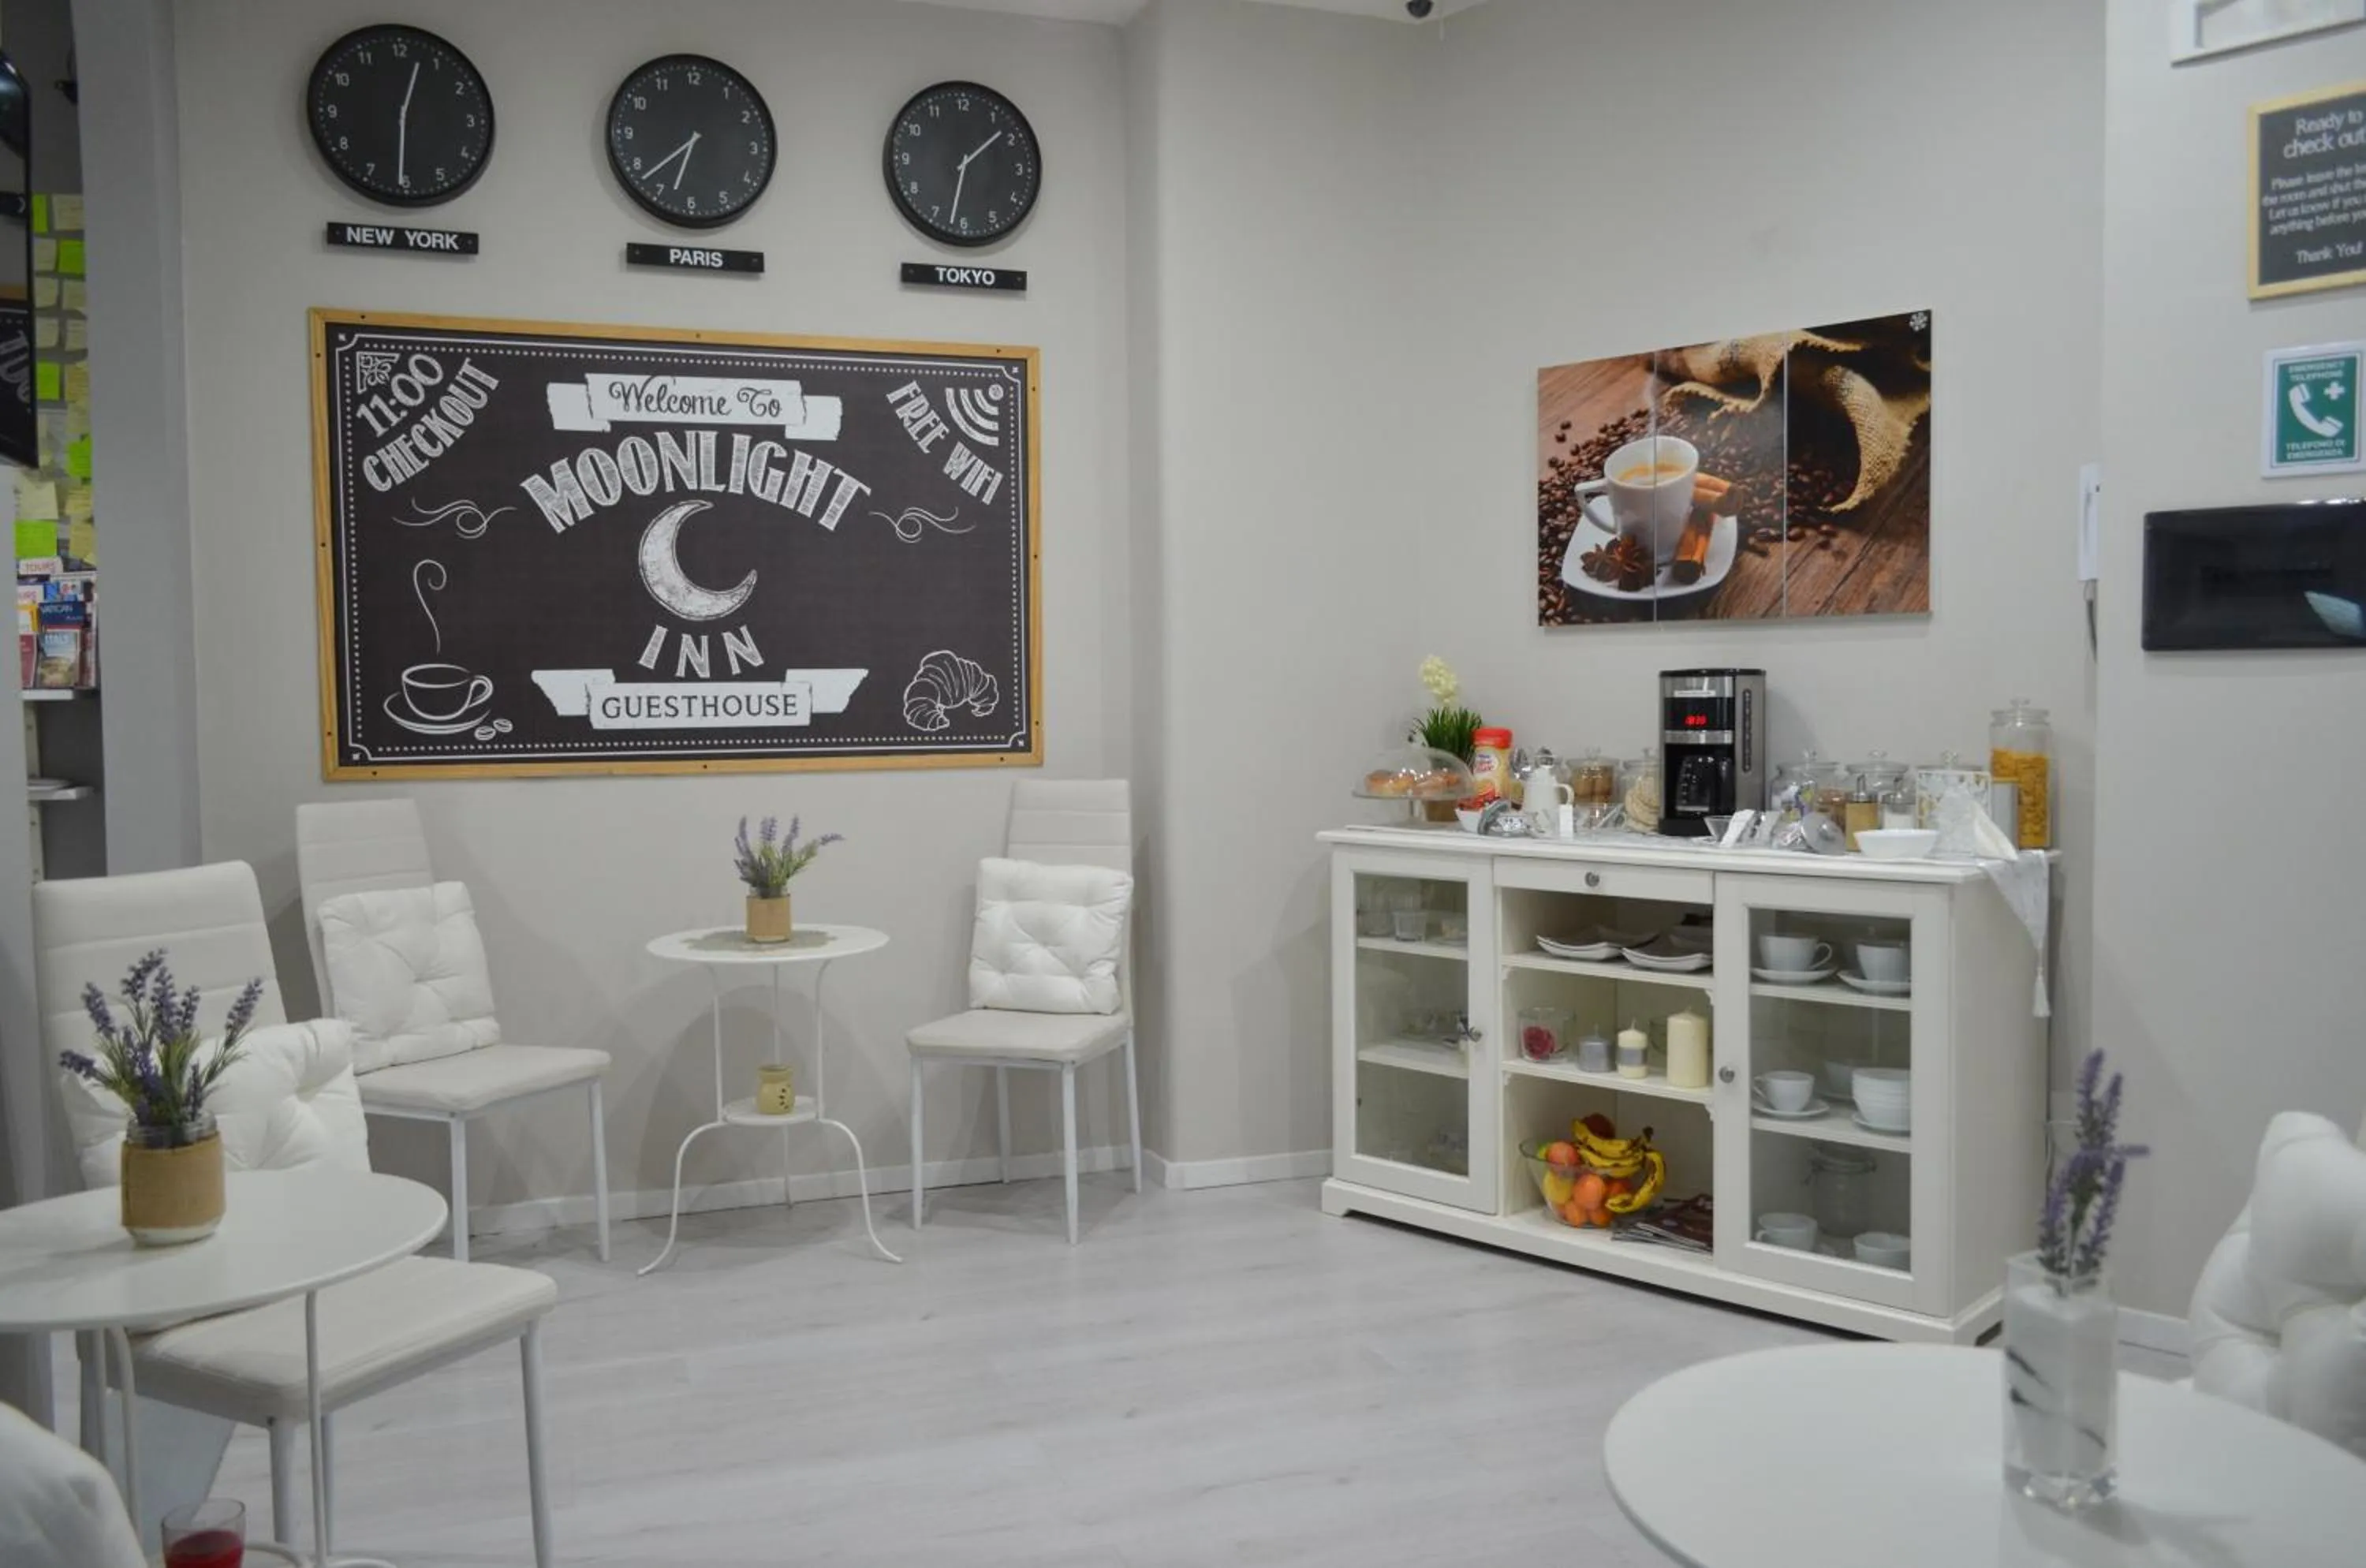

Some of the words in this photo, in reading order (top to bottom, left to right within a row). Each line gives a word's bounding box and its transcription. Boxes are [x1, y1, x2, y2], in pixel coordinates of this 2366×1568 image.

[392, 43, 407, 58] 12
[358, 51, 371, 65] 11
[434, 58, 439, 70] 1
[335, 73, 349, 87] 10
[655, 79, 668, 91] 11
[688, 73, 700, 85] 12
[455, 82, 465, 95] 2
[723, 87, 729, 99] 1
[633, 96, 646, 110] 10
[957, 99, 969, 111] 12
[327, 104, 337, 118] 9
[742, 110, 750, 124] 2
[928, 106, 939, 118] 11
[466, 114, 475, 128] 3
[991, 112, 996, 124] 1
[2296, 113, 2345, 136] Ready
[625, 127, 633, 140] 9
[909, 124, 920, 136] 10
[340, 136, 349, 150] 8
[1007, 133, 1015, 146] 2
[2283, 133, 2335, 159] check
[461, 147, 468, 158] 4
[750, 142, 758, 155] 3
[633, 157, 641, 170] 8
[901, 152, 909, 165] 9
[366, 163, 375, 176] 7
[435, 168, 445, 181] 5
[1015, 163, 1023, 175] 3
[401, 175, 411, 189] 6
[744, 170, 751, 183] 4
[656, 184, 664, 196] 7
[910, 181, 918, 194] 8
[687, 196, 696, 209] 6
[719, 192, 728, 203] 5
[1010, 192, 1017, 203] 4
[931, 206, 939, 217] 7
[988, 211, 997, 223] 5
[960, 218, 968, 230] 6
[346, 226, 394, 245] NEW
[405, 230, 459, 250] YORK
[670, 248, 723, 267] PARIS
[2296, 245, 2333, 264] Thank
[935, 267, 996, 286] TOKYO
[356, 354, 444, 438] 11:00
[608, 375, 732, 415] Welcome
[737, 387, 782, 417] To
[886, 380, 950, 454] FREE
[363, 357, 499, 492] CHECKOUT
[943, 441, 1003, 505] WIFI
[520, 430, 871, 535] MOONLIGHT
[637, 624, 764, 679] INN
[602, 693, 798, 719] GUESTHOUSE
